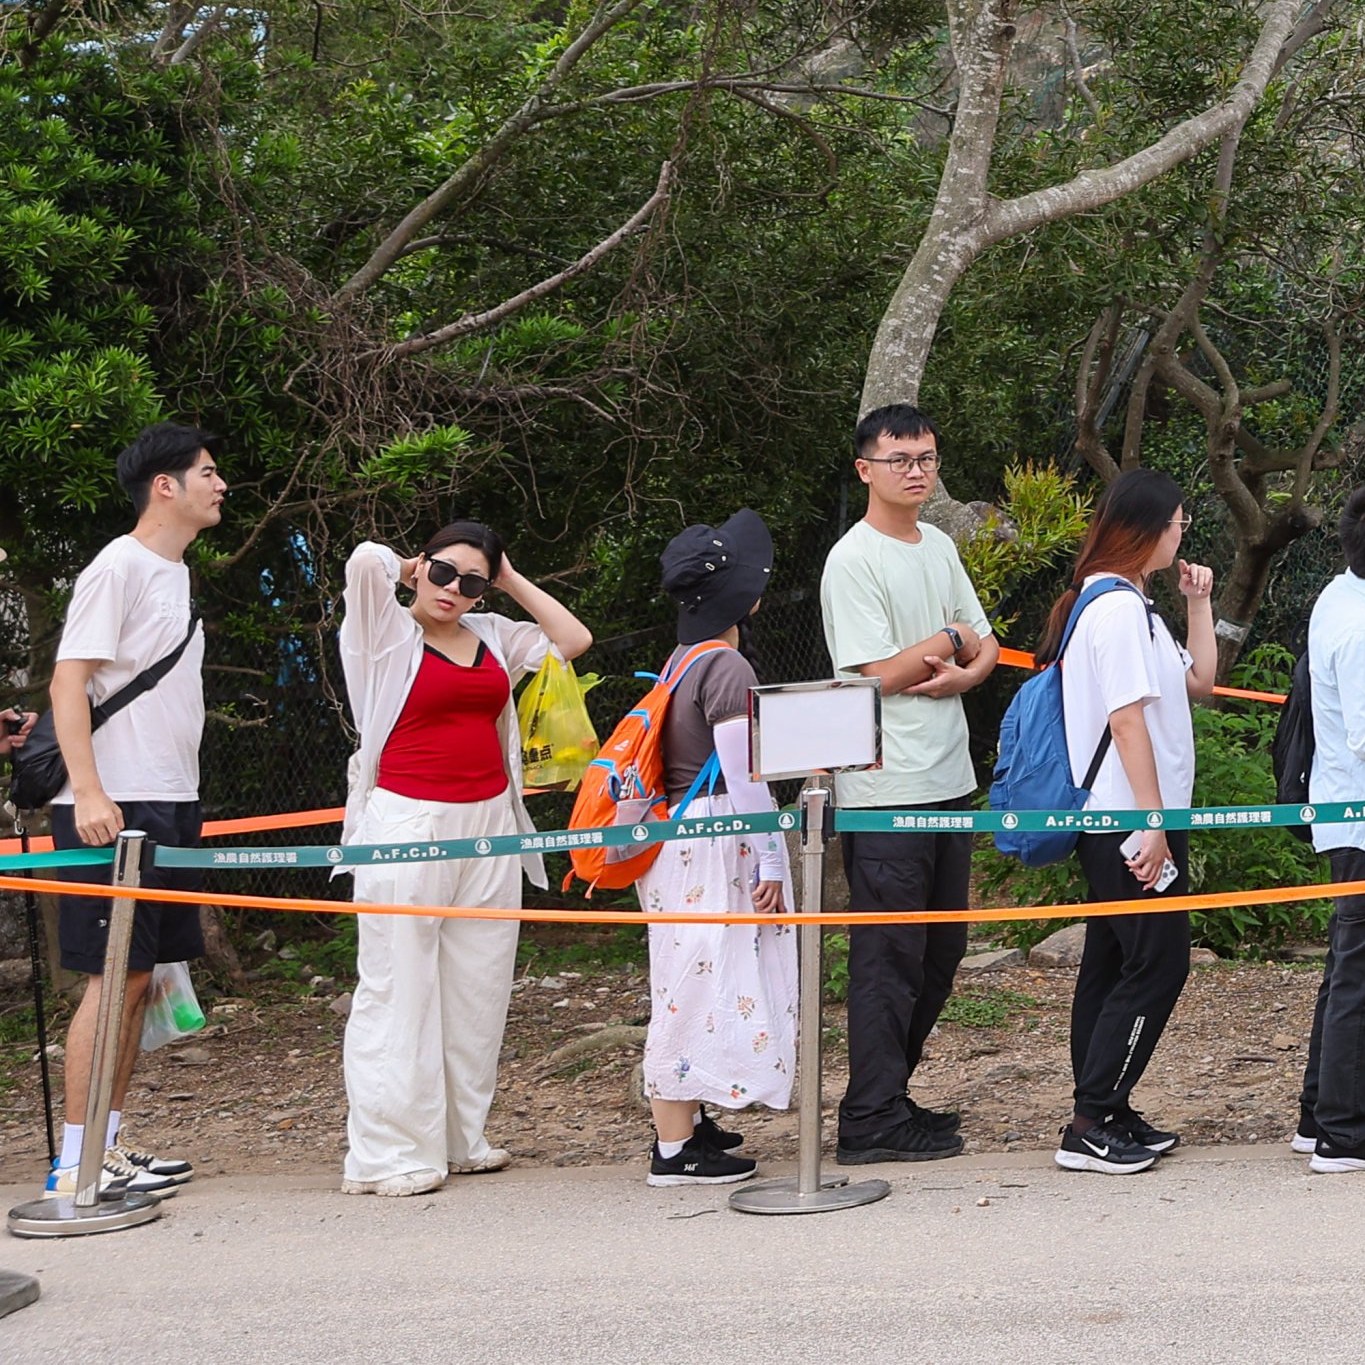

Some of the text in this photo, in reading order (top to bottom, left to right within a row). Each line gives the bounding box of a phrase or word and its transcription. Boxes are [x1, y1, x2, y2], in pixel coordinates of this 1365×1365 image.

[892, 815, 973, 829] 漁農自然護理署
[1190, 810, 1272, 826] 漁農自然護理署
[520, 831, 603, 851] 漁農自然護理署
[213, 852, 297, 864] 漁農自然護理署
